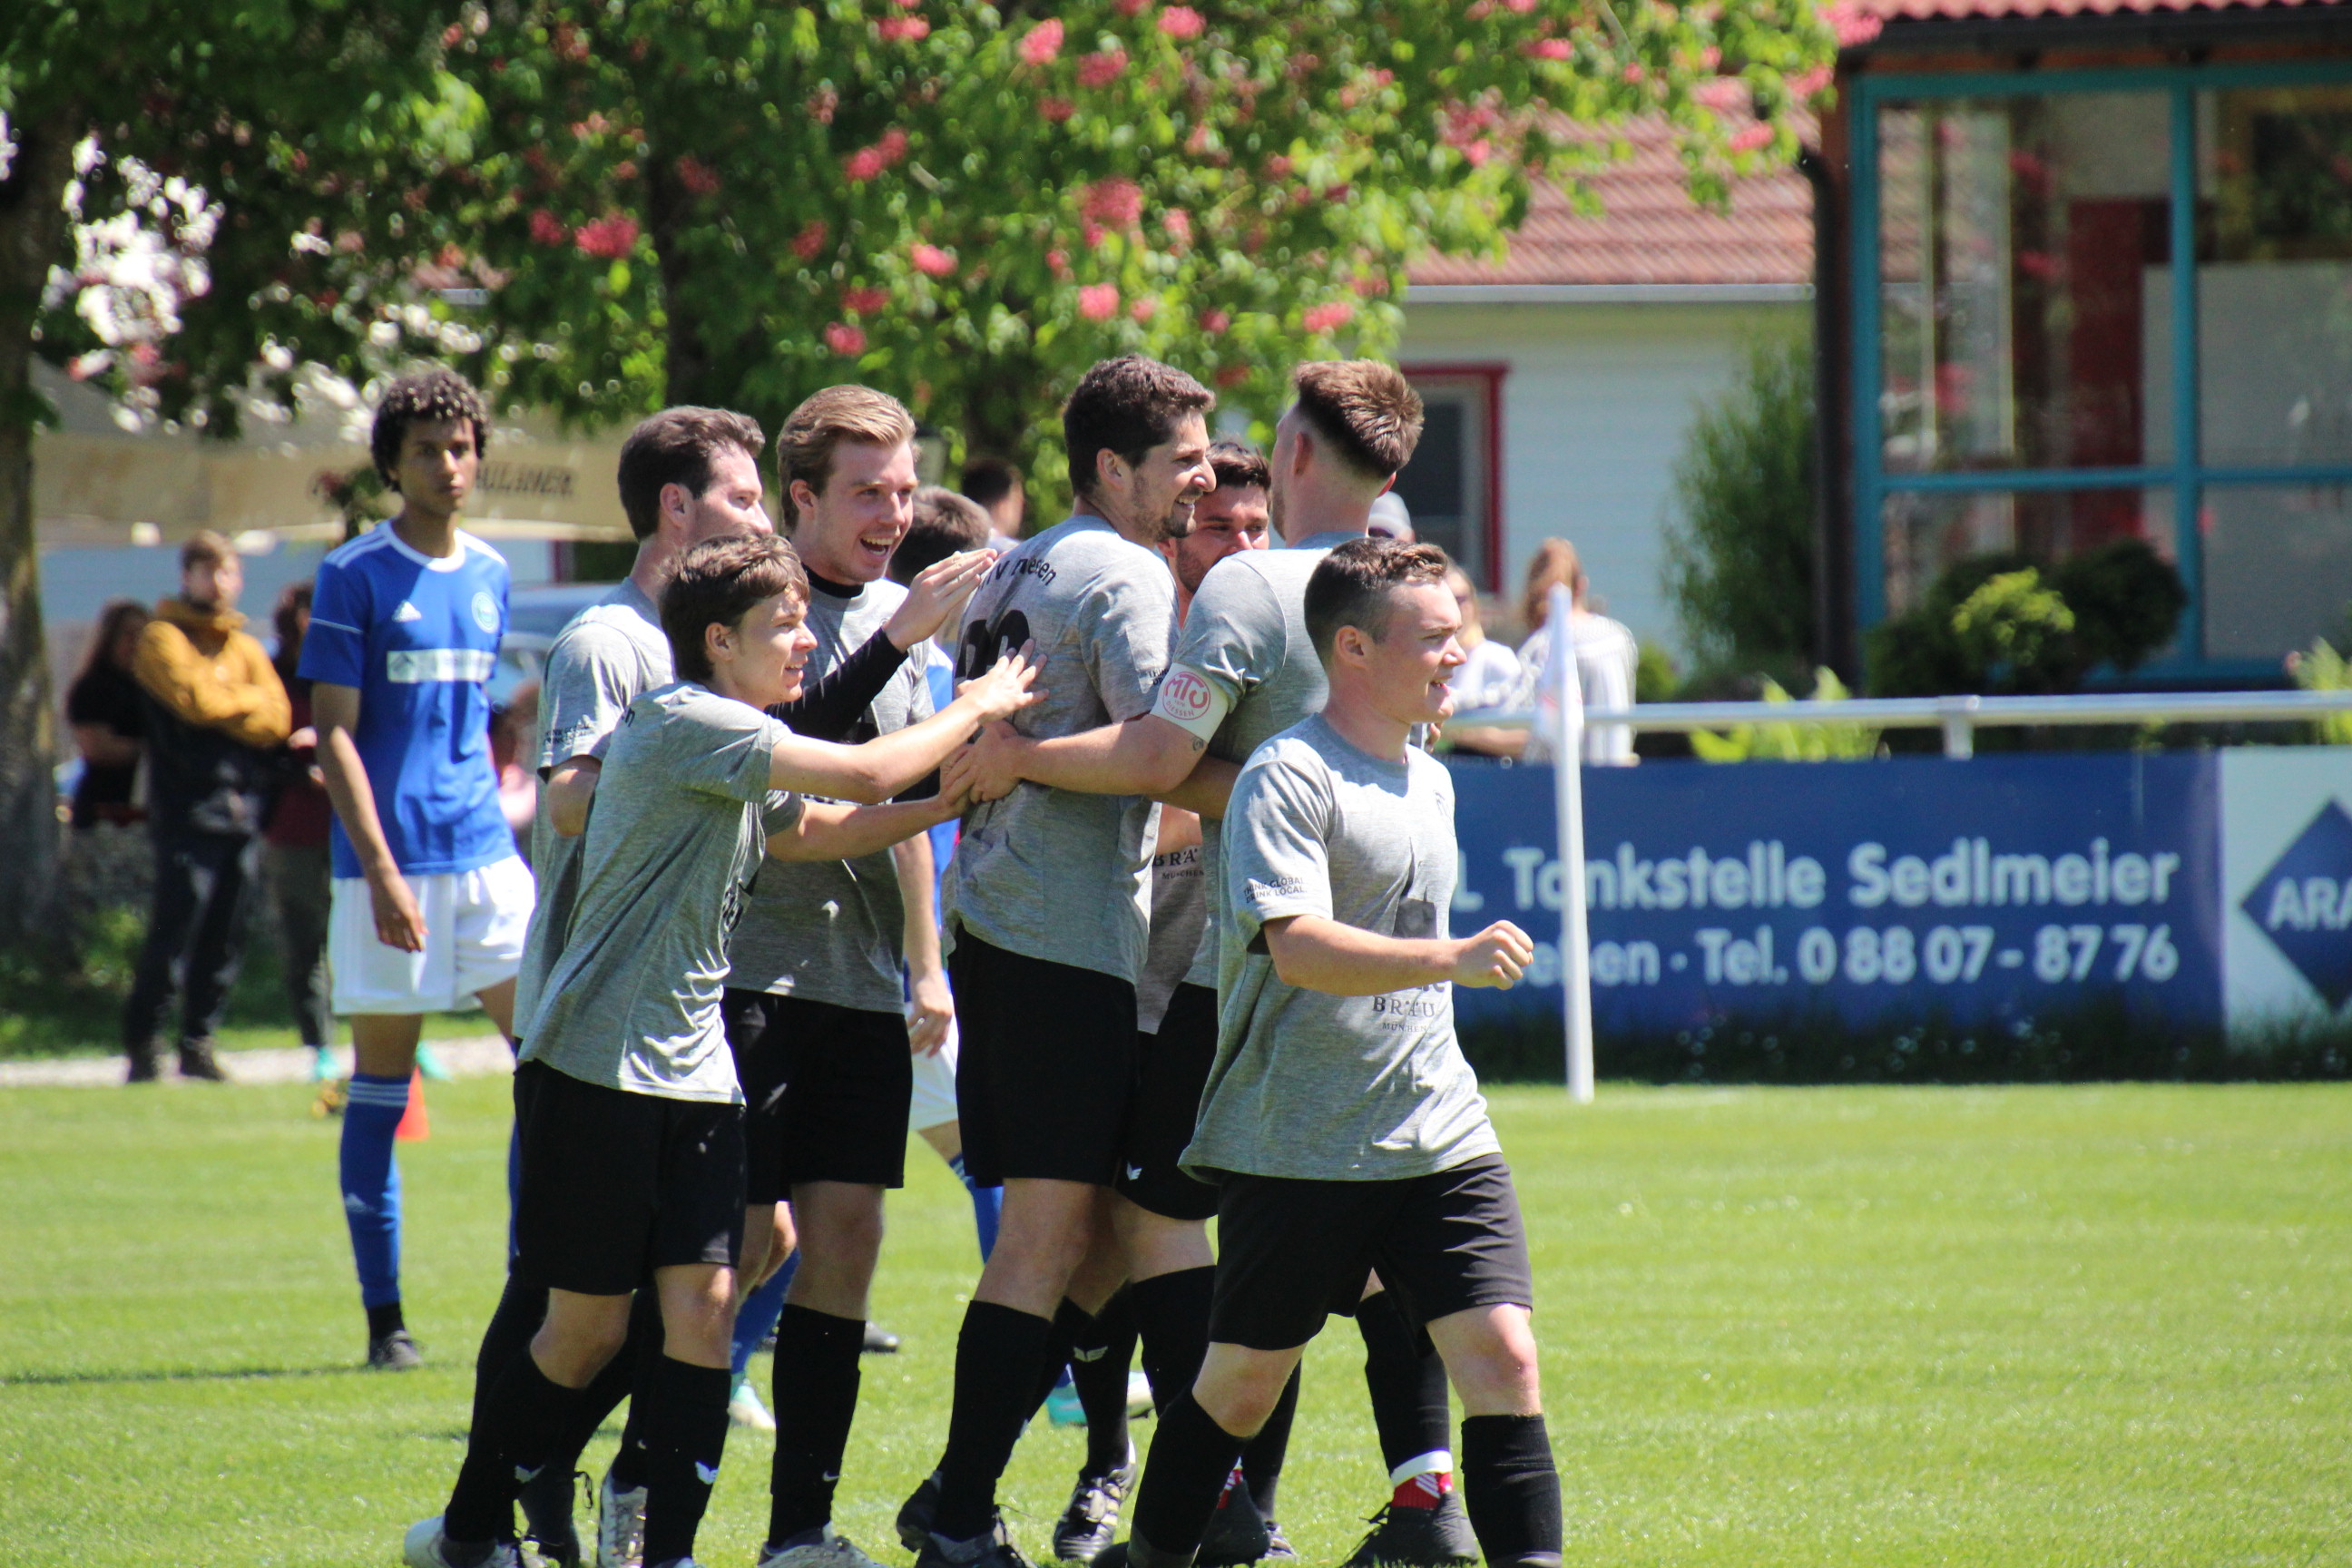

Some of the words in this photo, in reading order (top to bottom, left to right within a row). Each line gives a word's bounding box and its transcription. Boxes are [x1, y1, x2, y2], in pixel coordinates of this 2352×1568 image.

[1166, 701, 1195, 717] DIESSEN
[1847, 836, 2180, 908] Sedlmeier
[1244, 882, 1268, 897] THINK
[1246, 890, 1271, 904] DRINK
[1694, 924, 1789, 986] Tel.
[1372, 995, 1435, 1017] BRÄU
